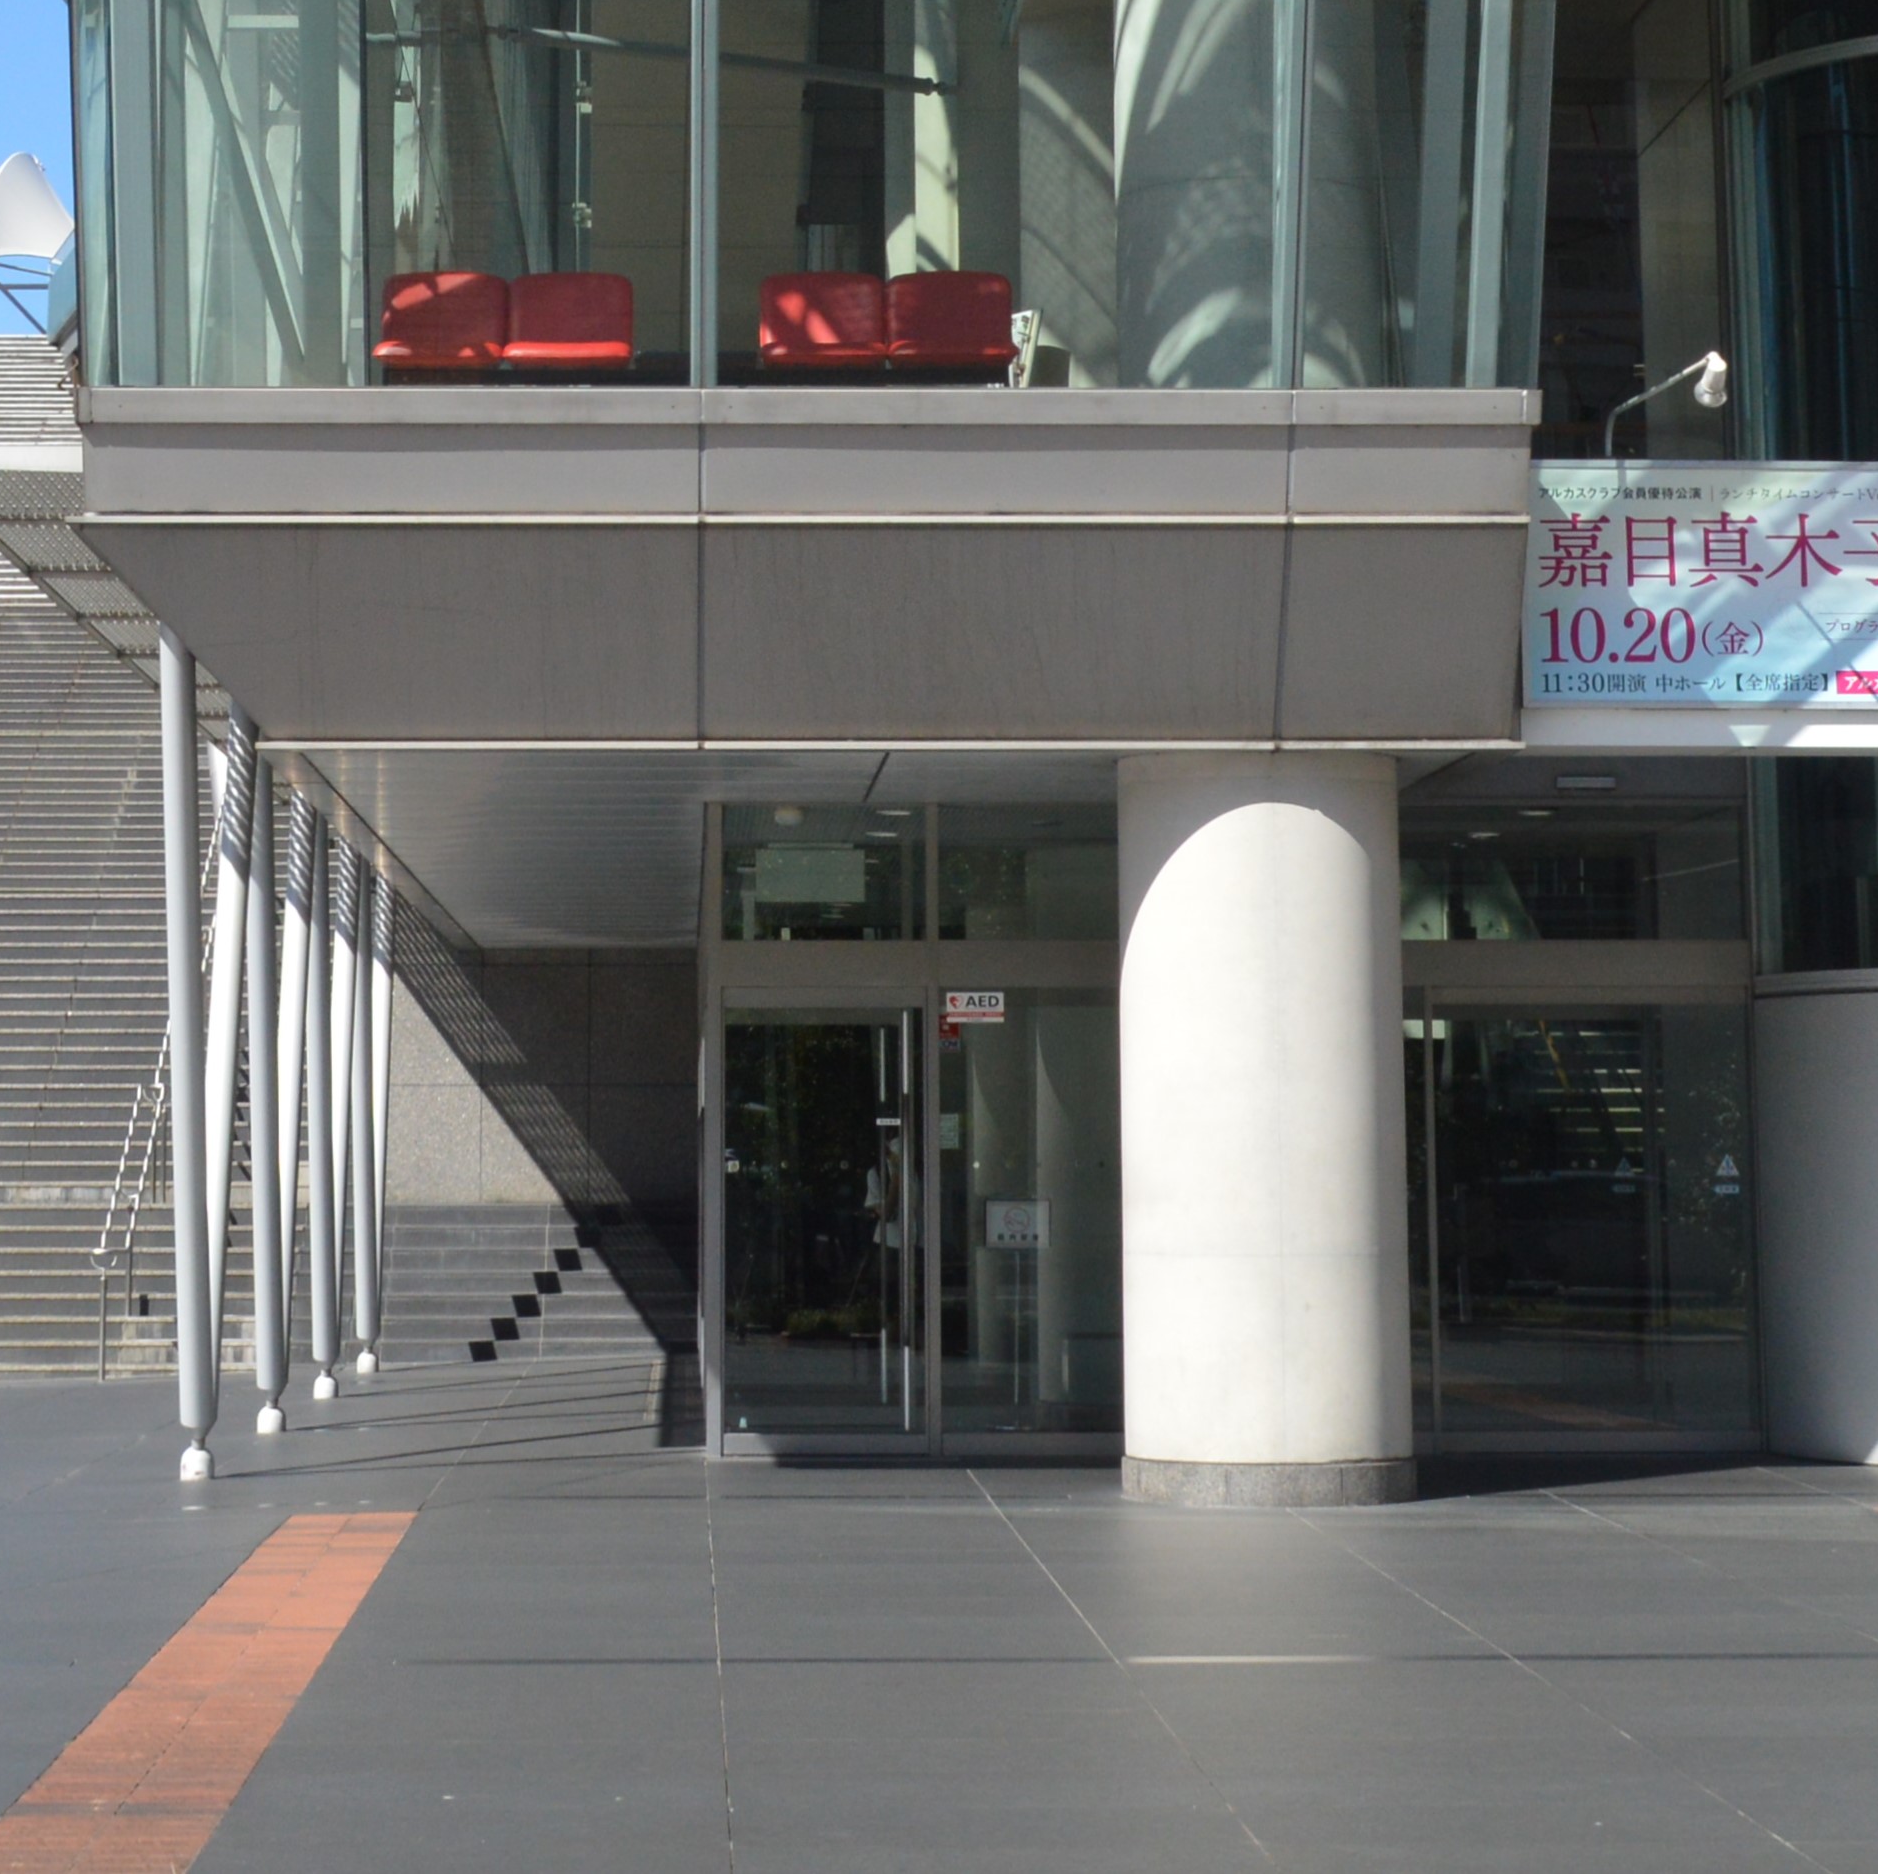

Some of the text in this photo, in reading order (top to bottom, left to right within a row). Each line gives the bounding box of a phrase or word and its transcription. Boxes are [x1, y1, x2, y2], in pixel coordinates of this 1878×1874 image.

[1538, 486, 1703, 501] アルカスクラブ会員優待公演
[1541, 673, 1647, 694] 11:30開演
[1655, 674, 1726, 692] 中ホール
[965, 994, 1000, 1009] AED
